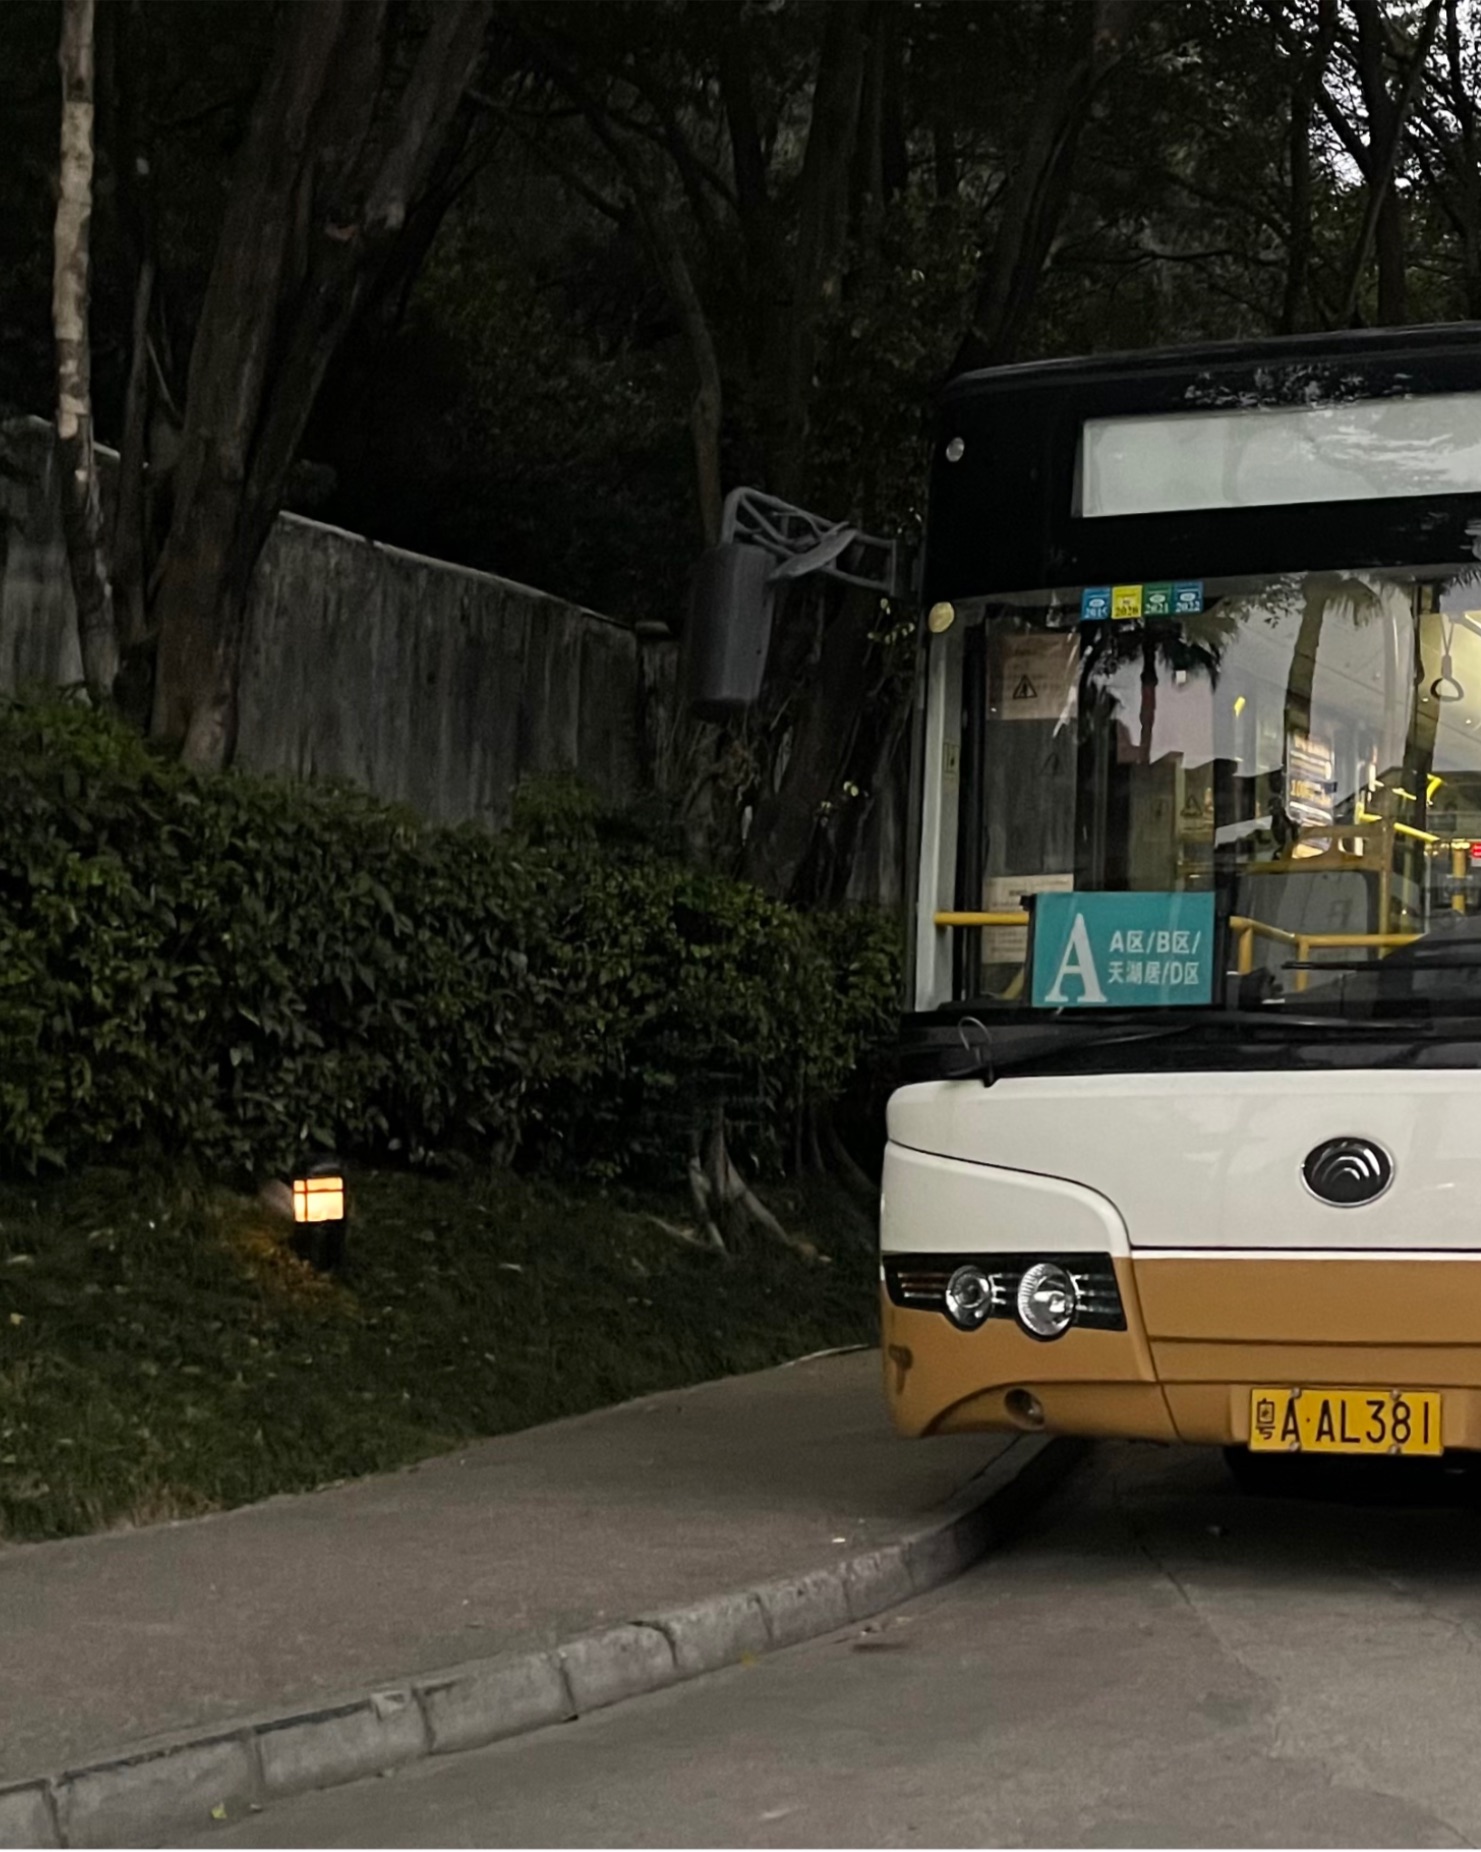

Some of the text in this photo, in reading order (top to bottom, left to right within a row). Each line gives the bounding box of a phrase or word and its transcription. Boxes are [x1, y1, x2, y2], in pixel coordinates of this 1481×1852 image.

[1144, 602, 1169, 615] 2021
[1175, 600, 1201, 613] 2022
[1108, 929, 1202, 955] A区/B区/
[1044, 912, 1108, 1003] A
[1106, 960, 1200, 986] 天湖居/D区
